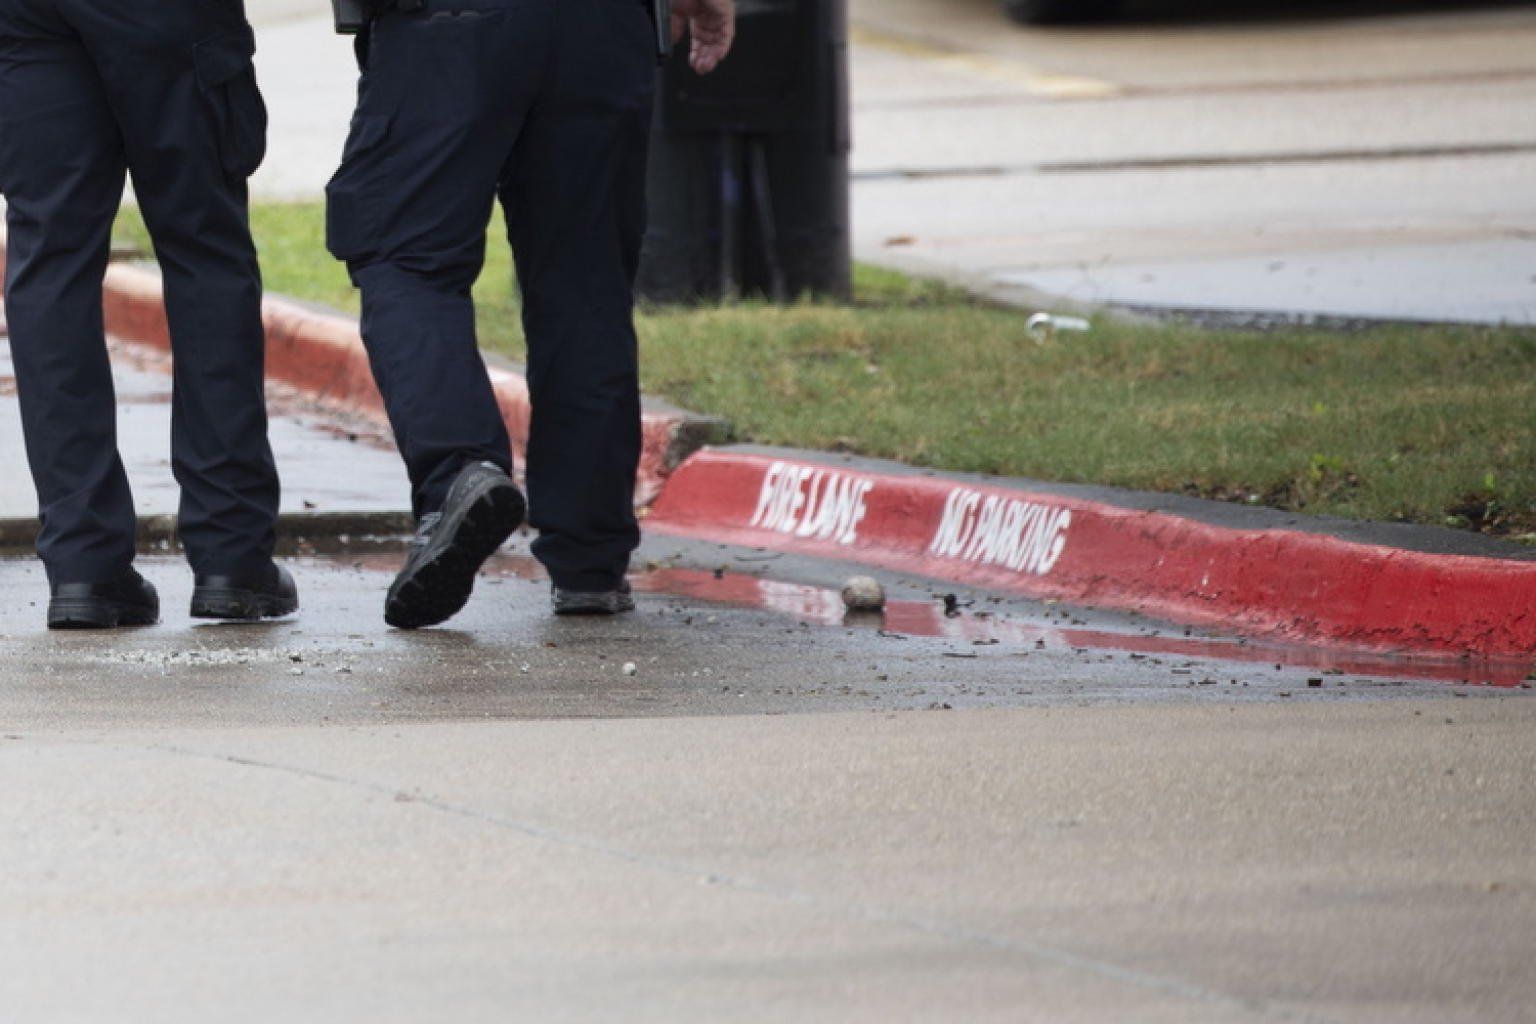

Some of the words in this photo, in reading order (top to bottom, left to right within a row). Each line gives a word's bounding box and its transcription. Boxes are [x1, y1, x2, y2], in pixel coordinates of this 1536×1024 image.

[749, 462, 813, 534] FIRE
[795, 470, 873, 545] LANE
[929, 487, 982, 558] NO
[963, 495, 1071, 576] PARKING
